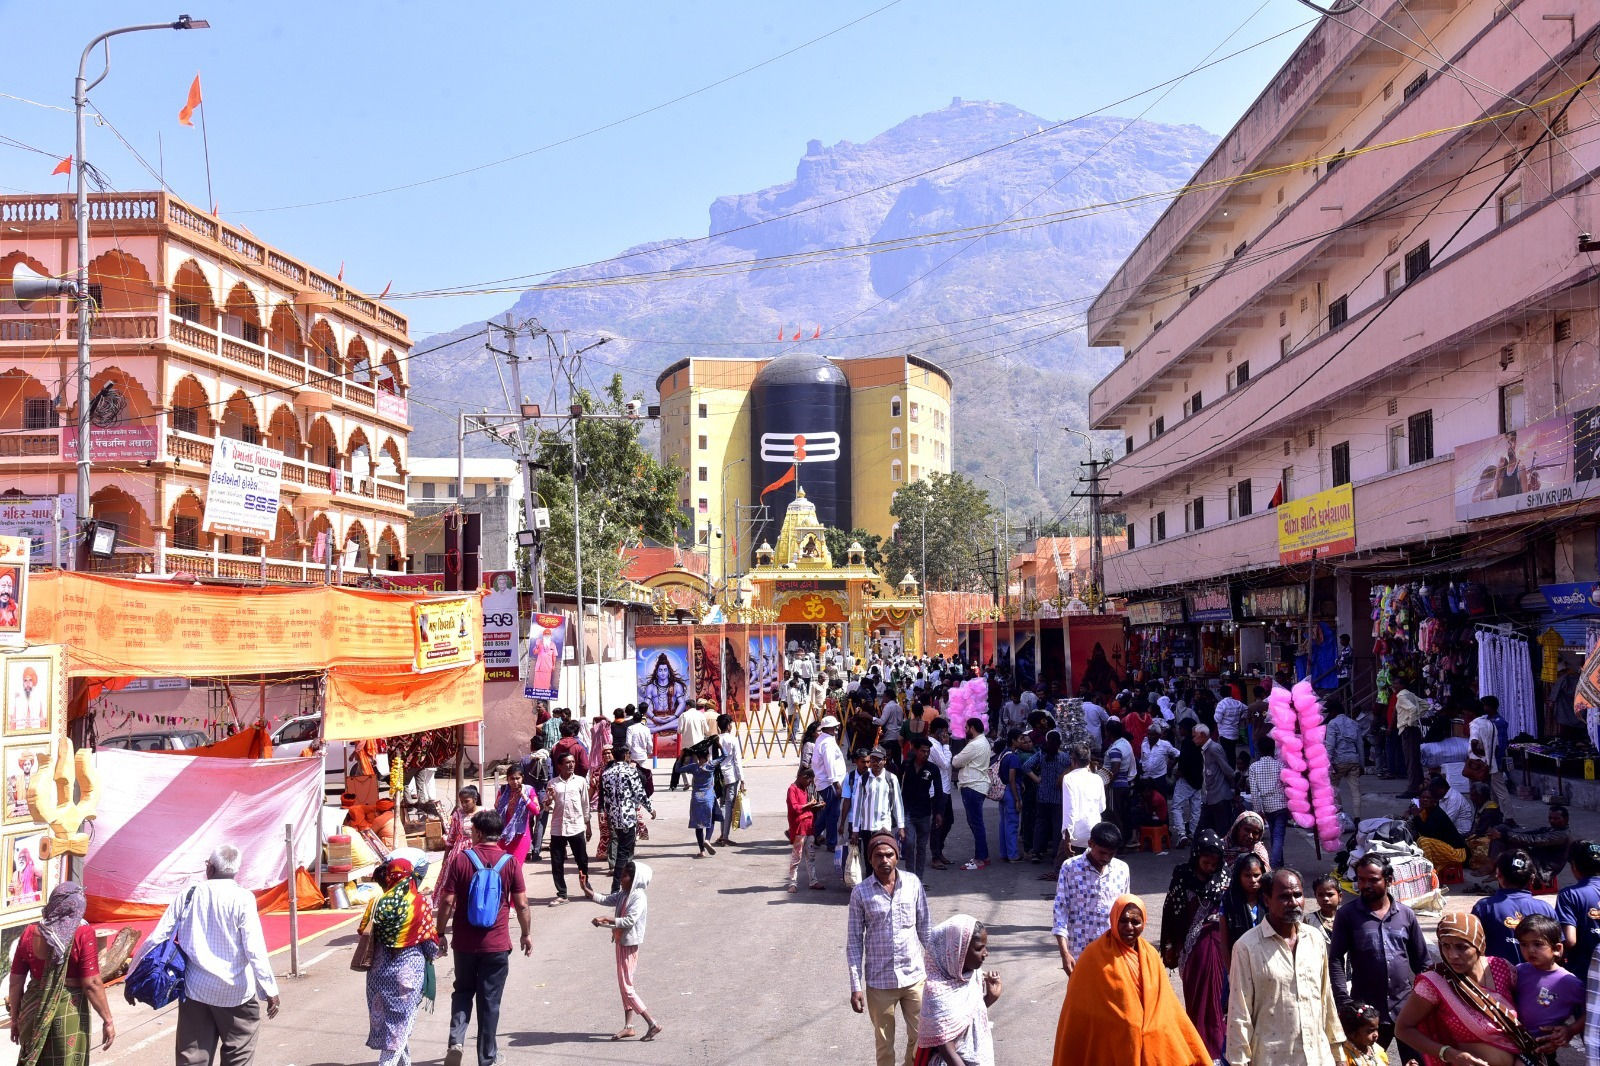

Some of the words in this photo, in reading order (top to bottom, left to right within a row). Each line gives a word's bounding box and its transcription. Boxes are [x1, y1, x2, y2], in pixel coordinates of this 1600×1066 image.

[1546, 487, 1573, 503] KRUPA
[1319, 500, 1351, 525] ધર્મશાળા
[802, 596, 825, 620] ॐ
